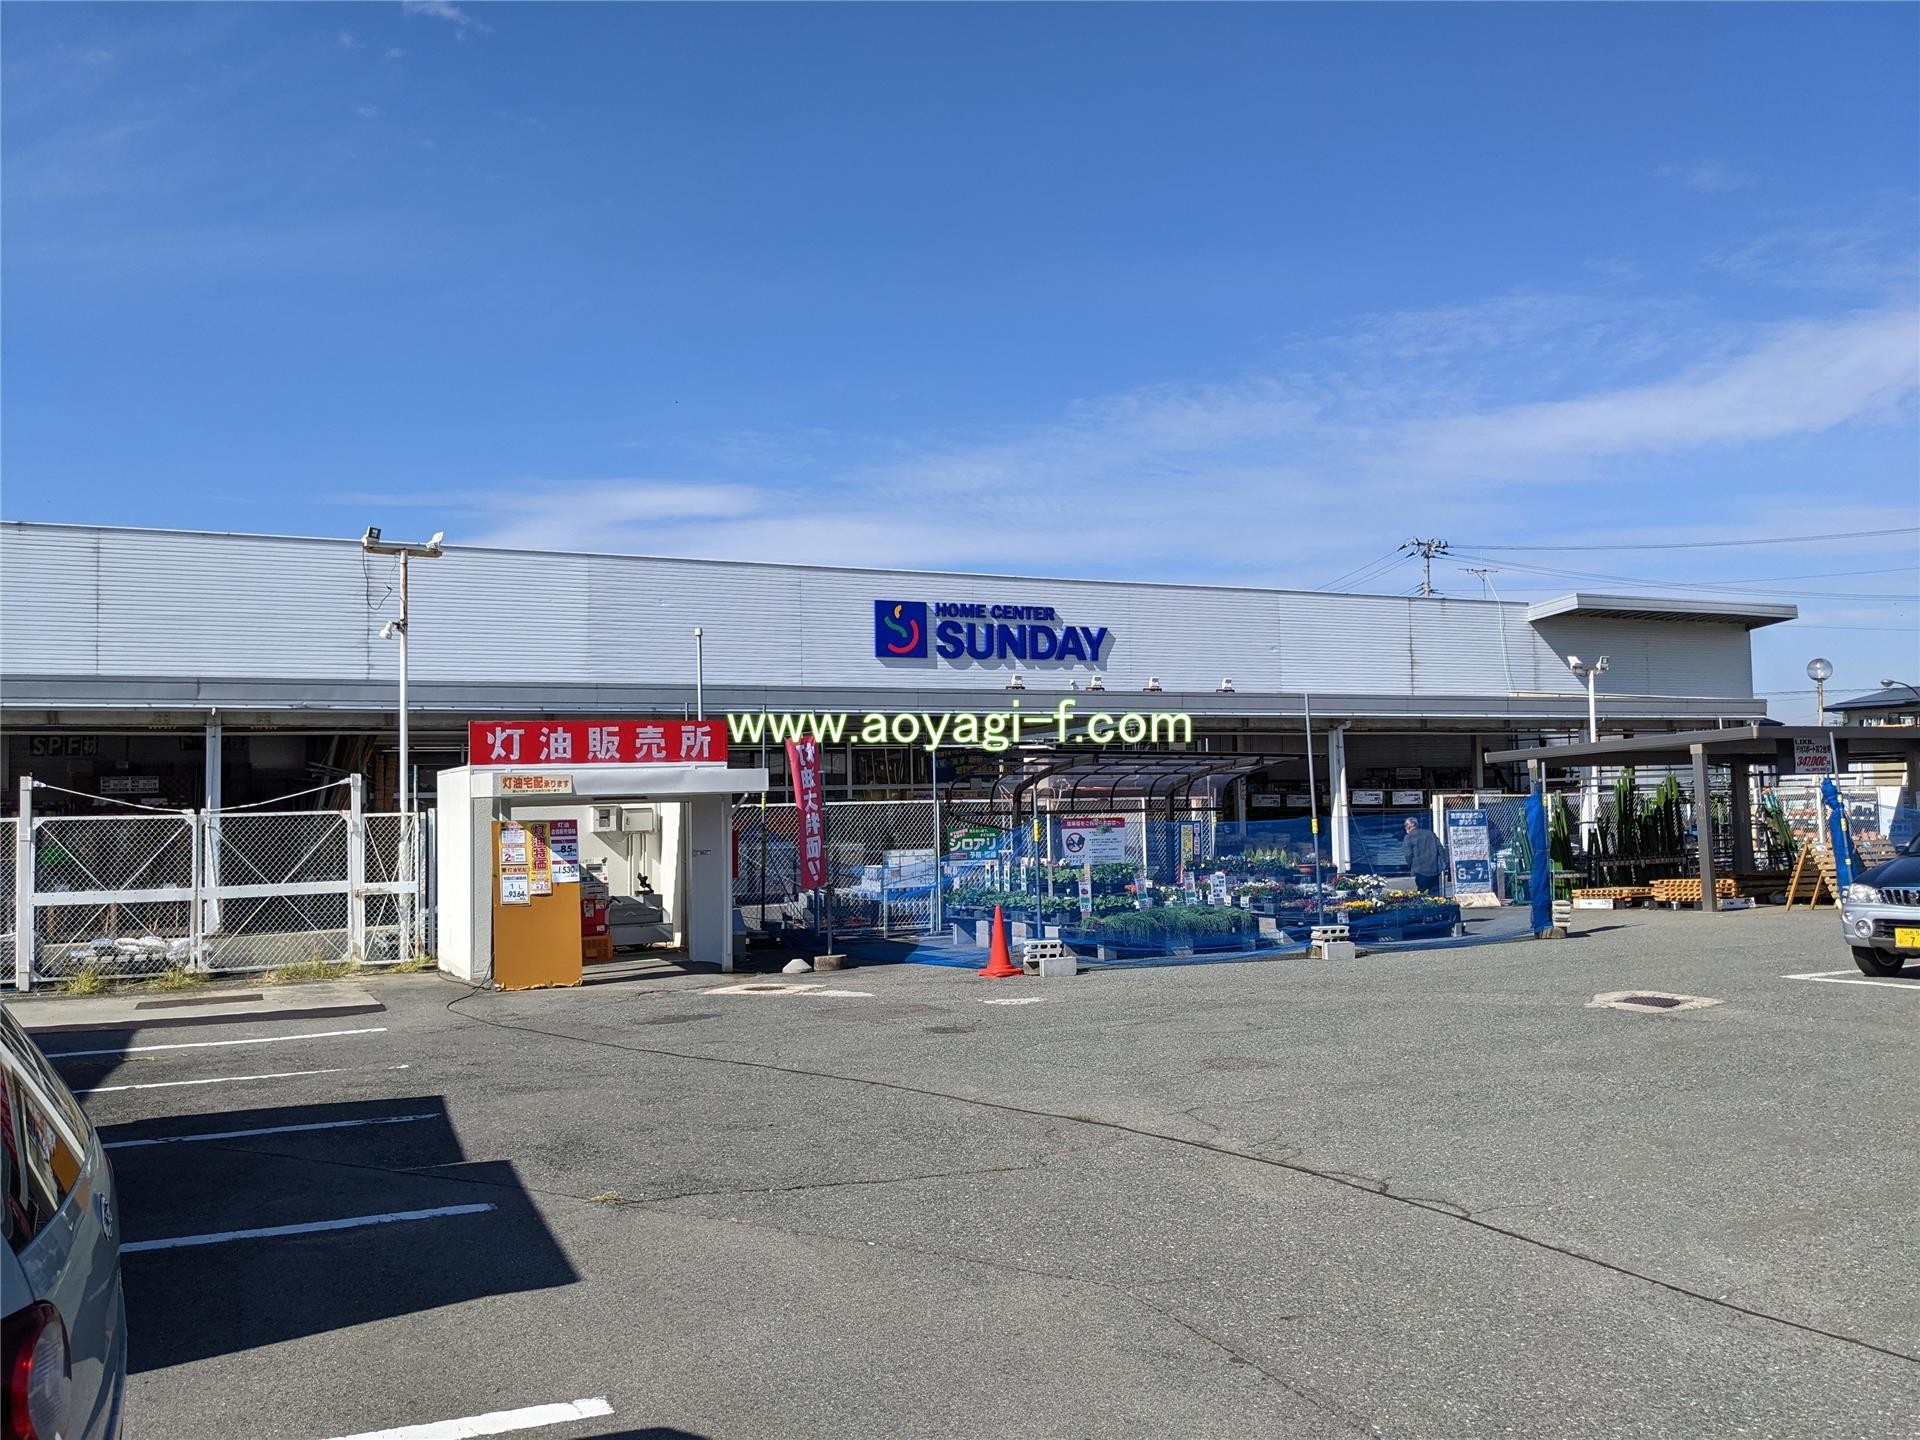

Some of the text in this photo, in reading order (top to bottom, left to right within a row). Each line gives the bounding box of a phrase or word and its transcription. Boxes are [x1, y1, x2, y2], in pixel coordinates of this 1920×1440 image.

[935, 602, 1056, 621] HOME CENTER
[936, 621, 1108, 661] SUNDAY
[486, 726, 712, 760] 灯油販売所
[502, 776, 569, 789] 灯油宅配承ります
[949, 837, 997, 851] シロアリ
